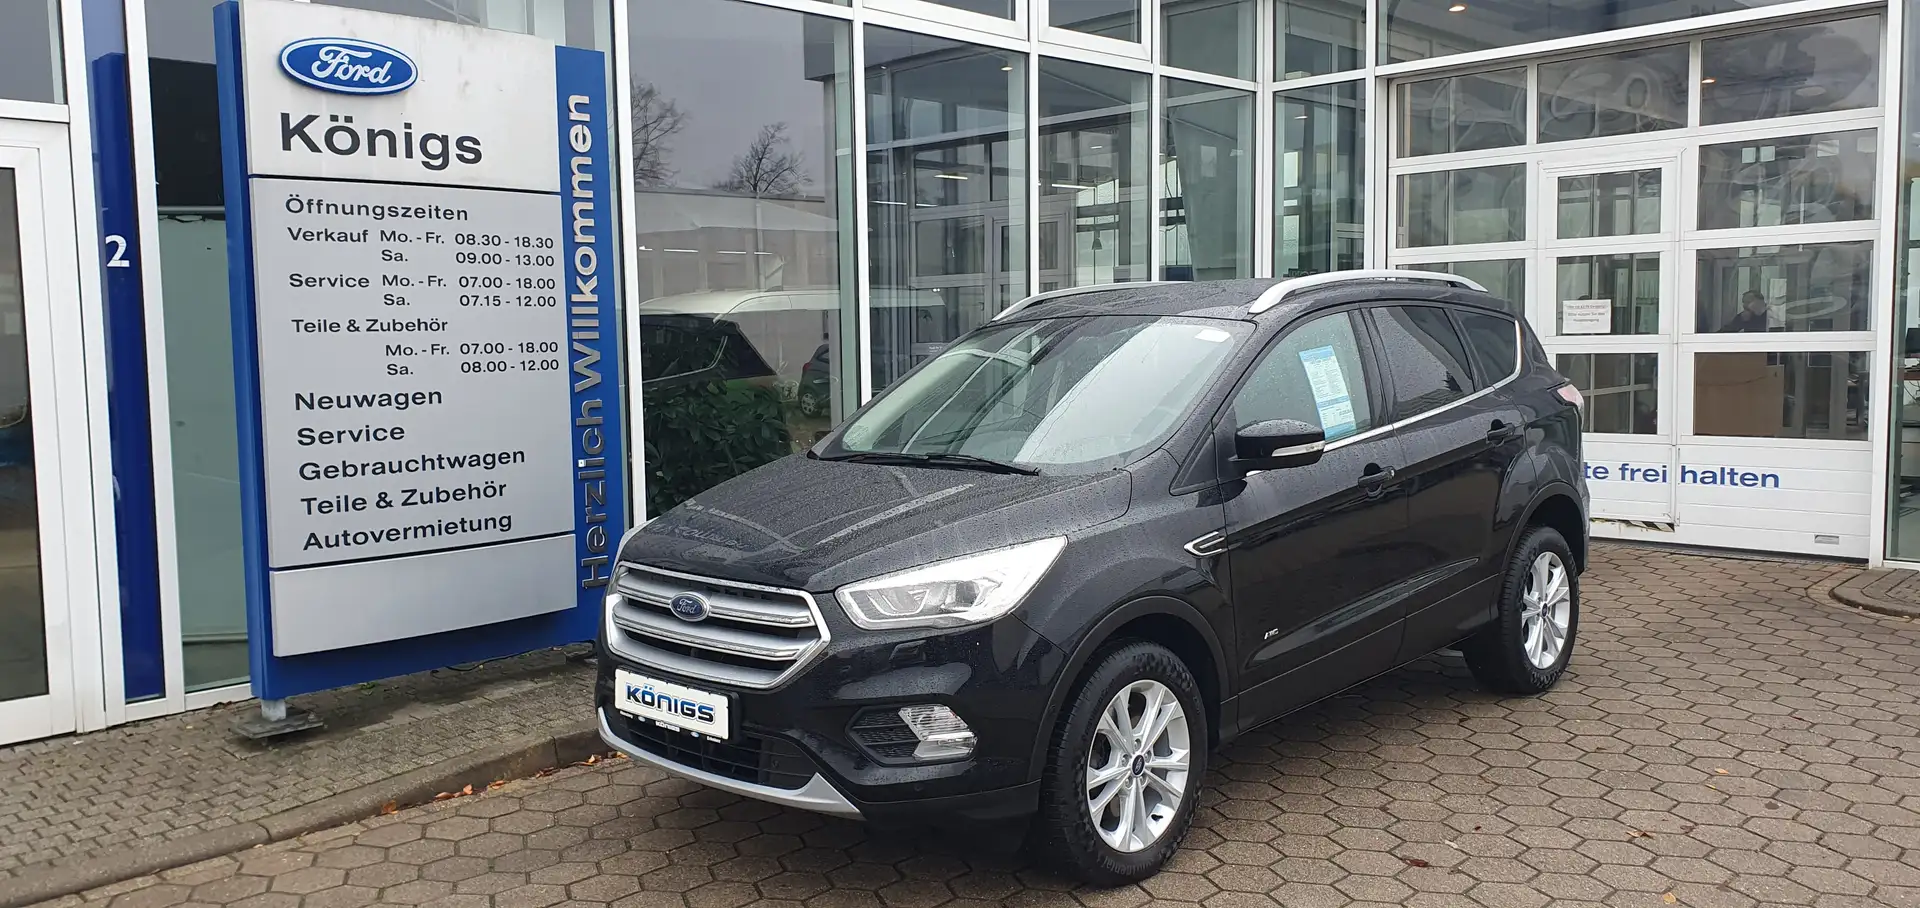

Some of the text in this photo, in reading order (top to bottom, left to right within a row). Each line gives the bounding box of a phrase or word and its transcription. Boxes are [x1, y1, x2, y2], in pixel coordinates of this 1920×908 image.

[311, 46, 392, 84] Ford
[280, 112, 483, 171] Königs
[286, 194, 468, 220] Öffnungszeiten
[288, 227, 368, 242] Verkauf
[380, 230, 412, 243] Mo.
[426, 232, 445, 244] Fr.
[455, 234, 501, 247] 08.30
[514, 236, 554, 249] 18.30
[105, 234, 130, 267] 2
[381, 250, 408, 262] Sa.
[456, 252, 502, 265] 09.00
[515, 255, 554, 267] 13.00
[289, 274, 370, 288] Service
[382, 274, 414, 287] Mo.
[428, 276, 447, 287] Fr.
[459, 276, 502, 288] 07.00
[517, 278, 555, 290] 18.00
[384, 294, 410, 306] Sa.
[459, 295, 501, 306] 07.15
[516, 296, 556, 307] 12.00
[292, 318, 448, 332] Teile & Zubehör
[386, 344, 418, 356] Mo.
[431, 344, 449, 355] Fr.
[460, 342, 504, 354] 07.00
[518, 342, 558, 354] 18.00
[568, 94, 609, 589] Herzlich Willkommen
[387, 363, 413, 376] Sa.
[461, 361, 506, 373] 08.00
[520, 360, 559, 372] 12.00
[294, 390, 442, 410] Neuwagen
[297, 425, 405, 446] Service
[299, 450, 525, 480] Gebrauchtwagen
[1619, 463, 1667, 483] frei
[1681, 465, 1779, 488] halten
[300, 481, 507, 516] Teile & Zubehör
[303, 514, 512, 550] Autovermietung
[677, 598, 697, 614] Ford
[627, 685, 715, 724] KÖNIGS
